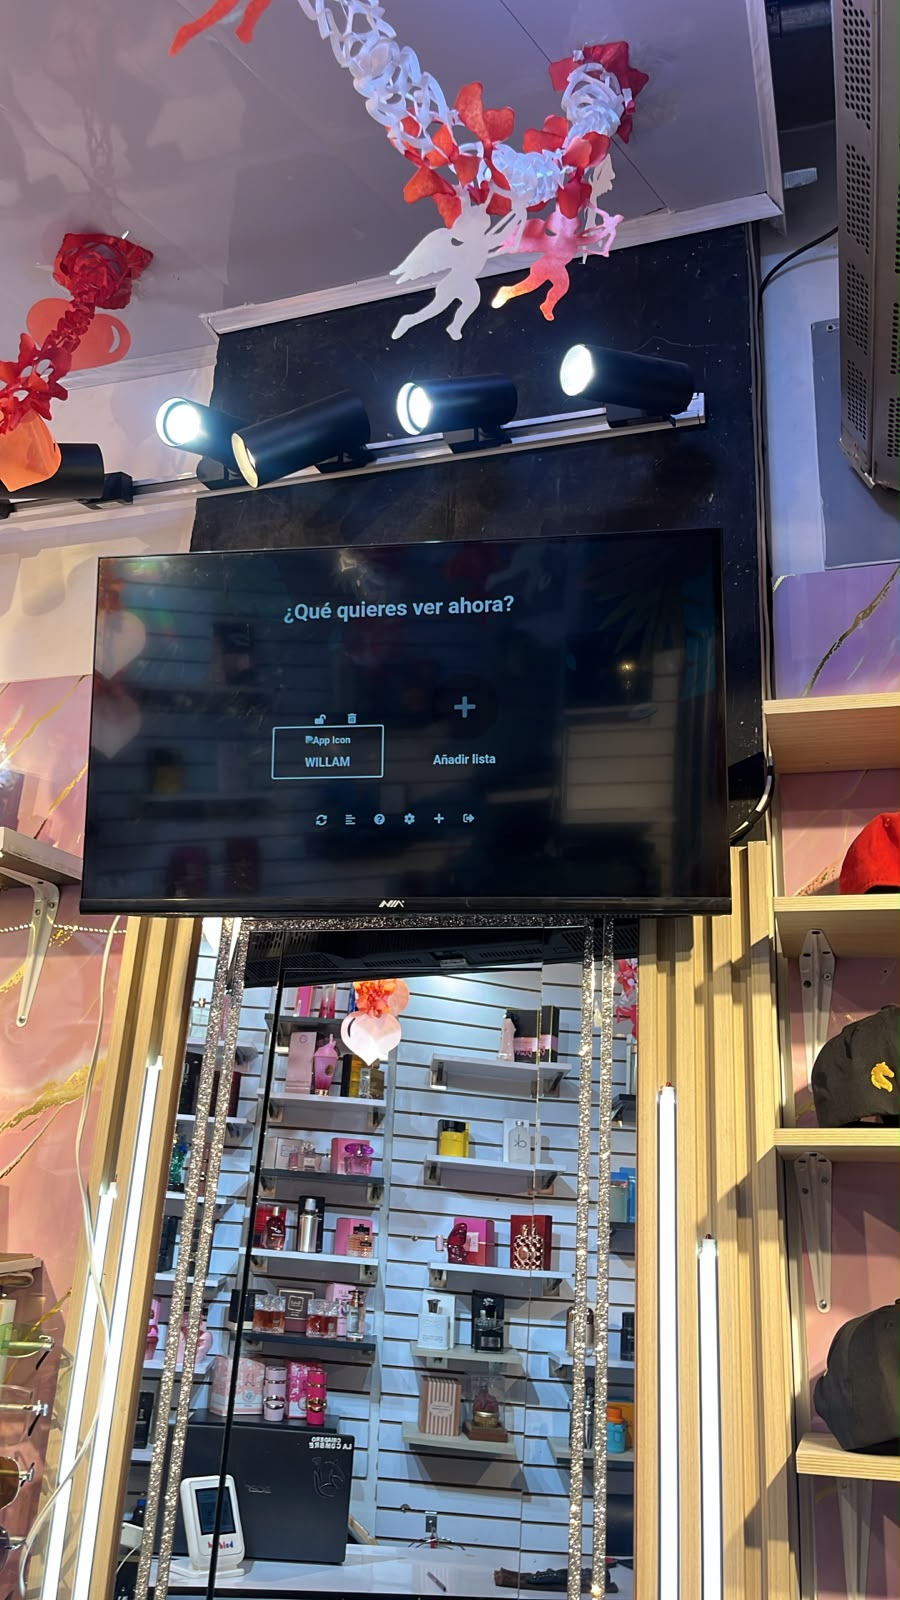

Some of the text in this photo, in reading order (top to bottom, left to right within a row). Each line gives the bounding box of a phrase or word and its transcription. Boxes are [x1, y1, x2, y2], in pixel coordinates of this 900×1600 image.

[284, 595, 514, 624] ¿Qué quieres ver ahora?
[313, 735, 351, 747] App Icon
[305, 756, 350, 768] WILLAM
[433, 753, 496, 765] Añadir lista
